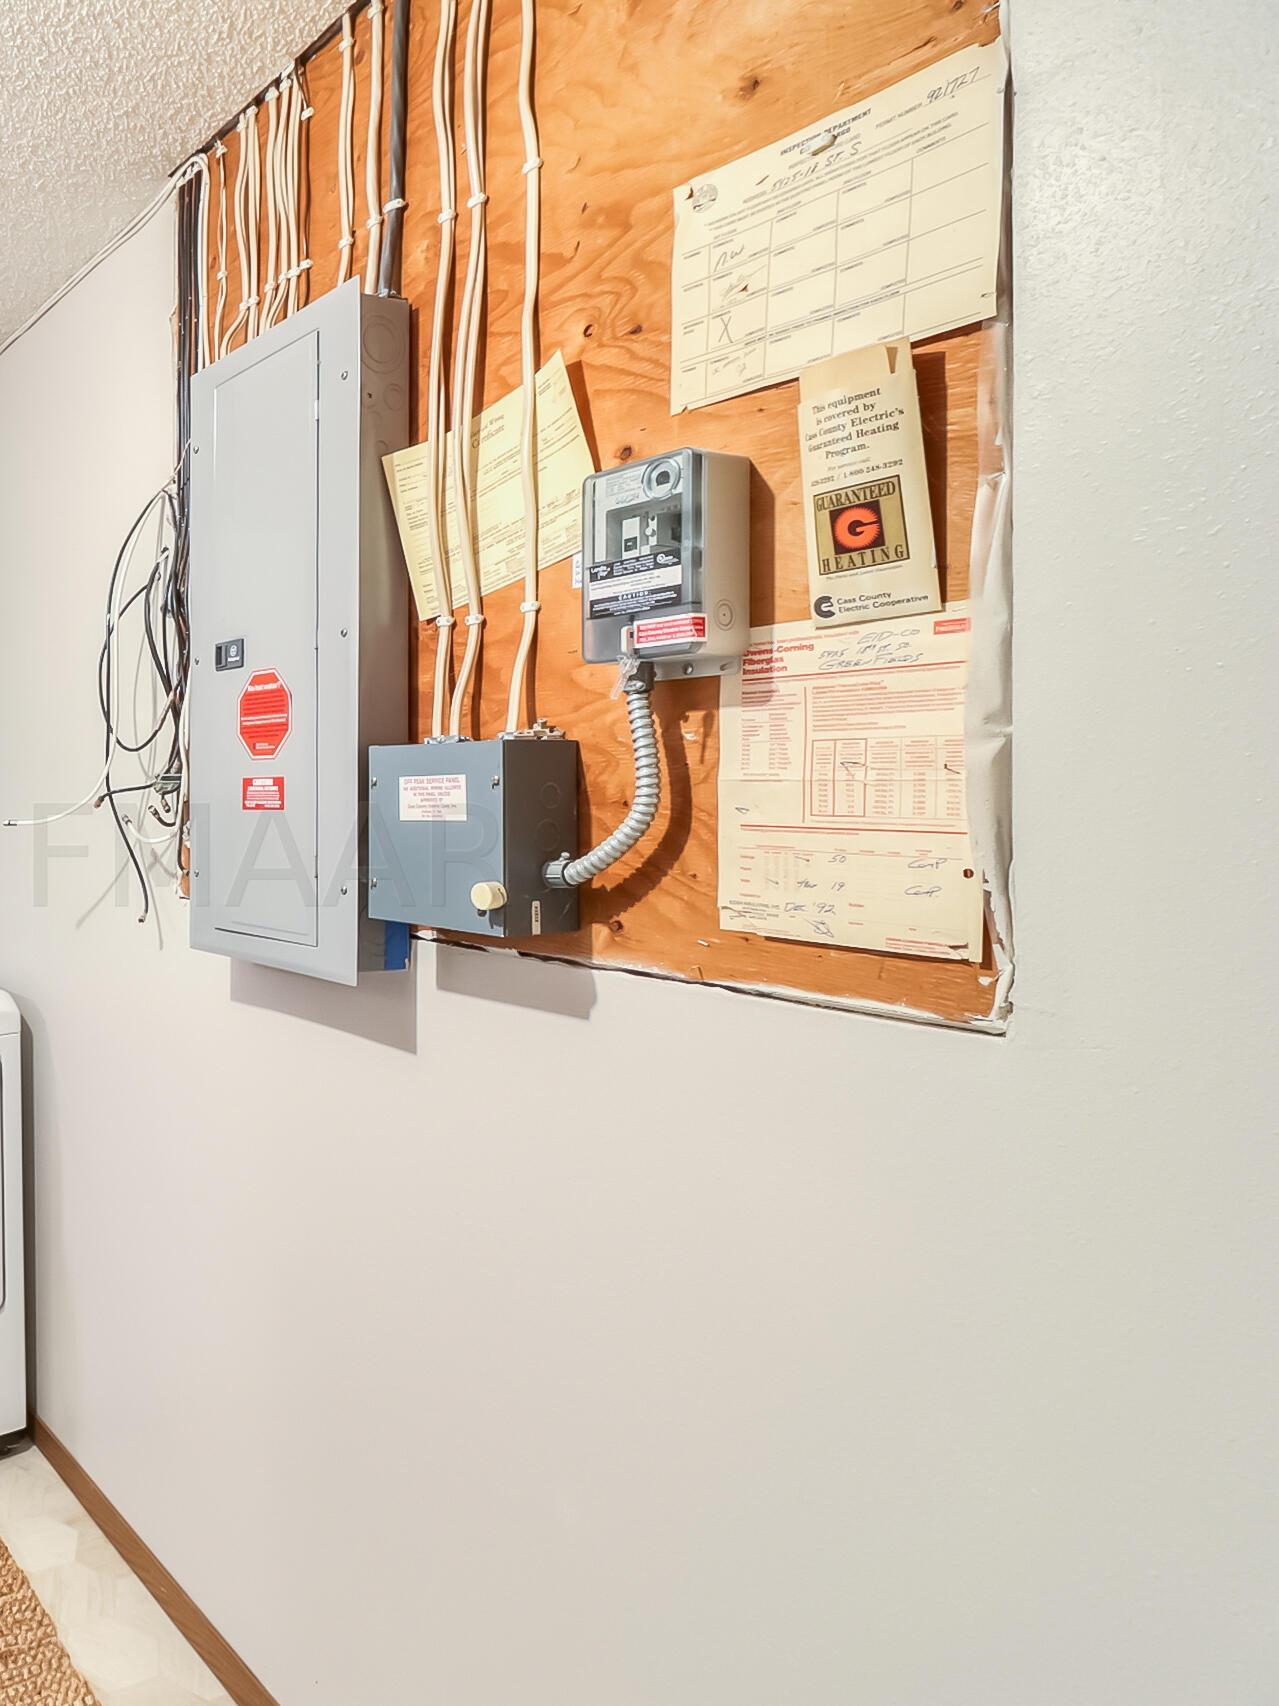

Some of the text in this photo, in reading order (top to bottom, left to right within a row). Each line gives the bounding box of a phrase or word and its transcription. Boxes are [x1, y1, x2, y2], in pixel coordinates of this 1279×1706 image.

[812, 387, 881, 415] This equipment
[824, 405, 860, 425] covered
[863, 401, 876, 414] by
[819, 422, 847, 438] County
[851, 407, 905, 428] Electric's
[808, 420, 900, 453] Guaranteed Heating
[825, 443, 870, 460] Program.
[816, 480, 896, 513] GUARANTEED
[821, 543, 904, 573] HEATING
[837, 591, 892, 607] Cass County
[838, 594, 929, 614] Electric Cooperative
[743, 656, 784, 667] Fiberglas
[743, 665, 788, 676] Insulation
